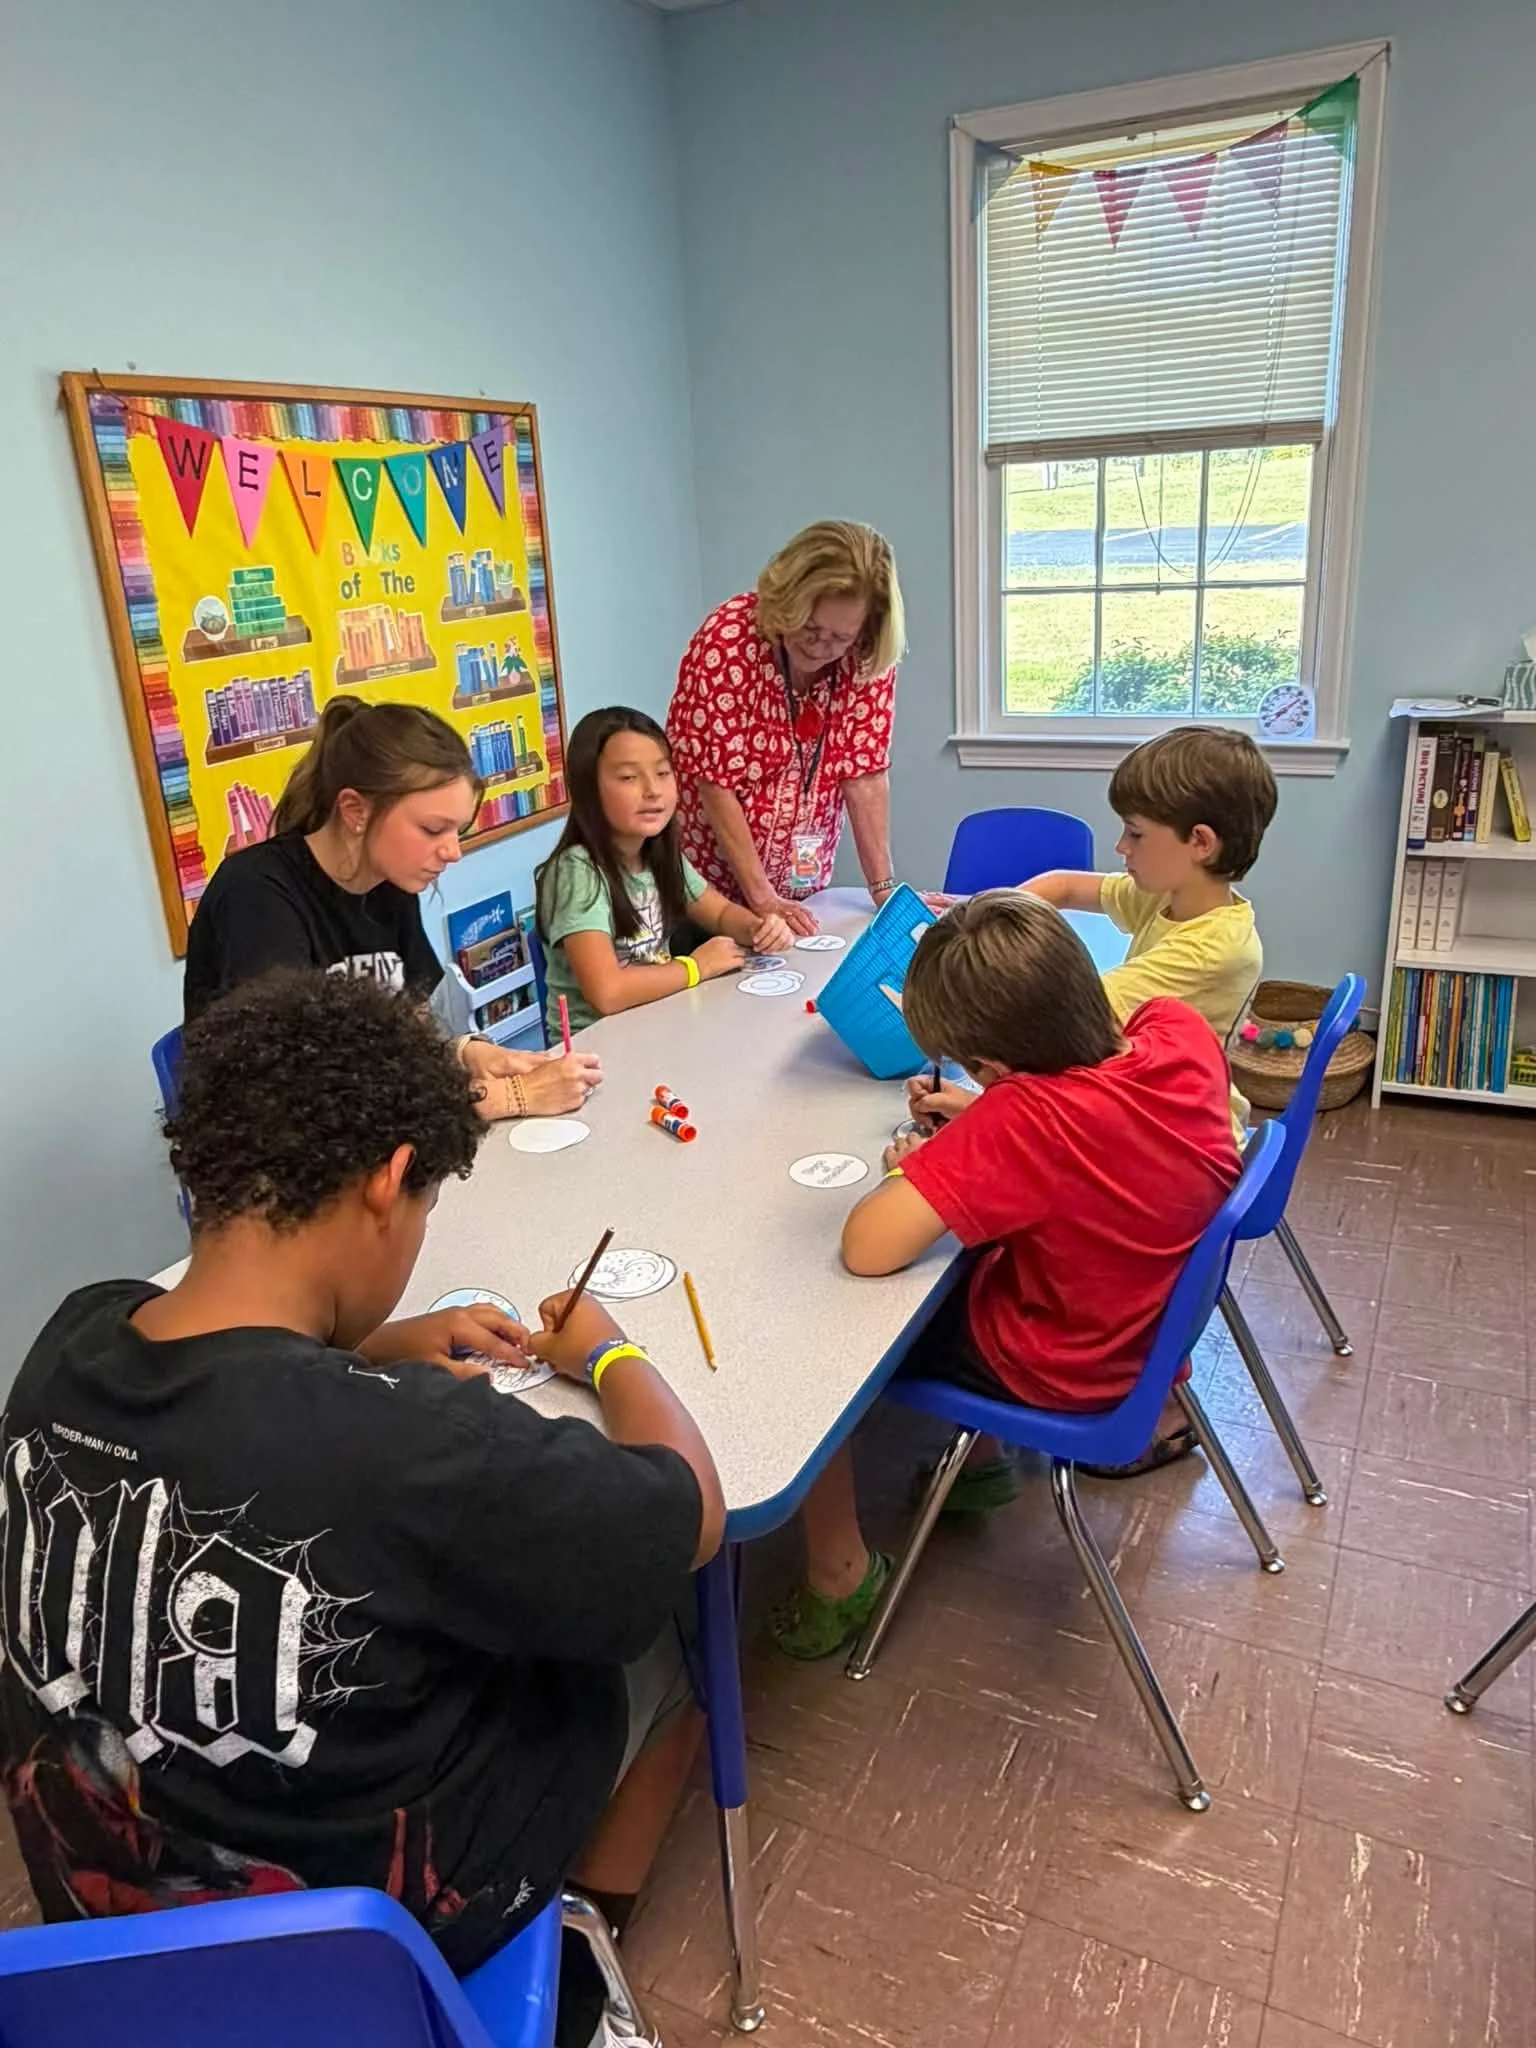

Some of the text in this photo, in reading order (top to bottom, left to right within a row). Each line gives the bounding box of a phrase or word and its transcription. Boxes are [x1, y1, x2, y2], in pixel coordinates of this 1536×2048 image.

[168, 437, 501, 497] WELCOME
[341, 541, 400, 566] Bks
[341, 570, 415, 600] of The
[1415, 767, 1429, 804] PICTURE
